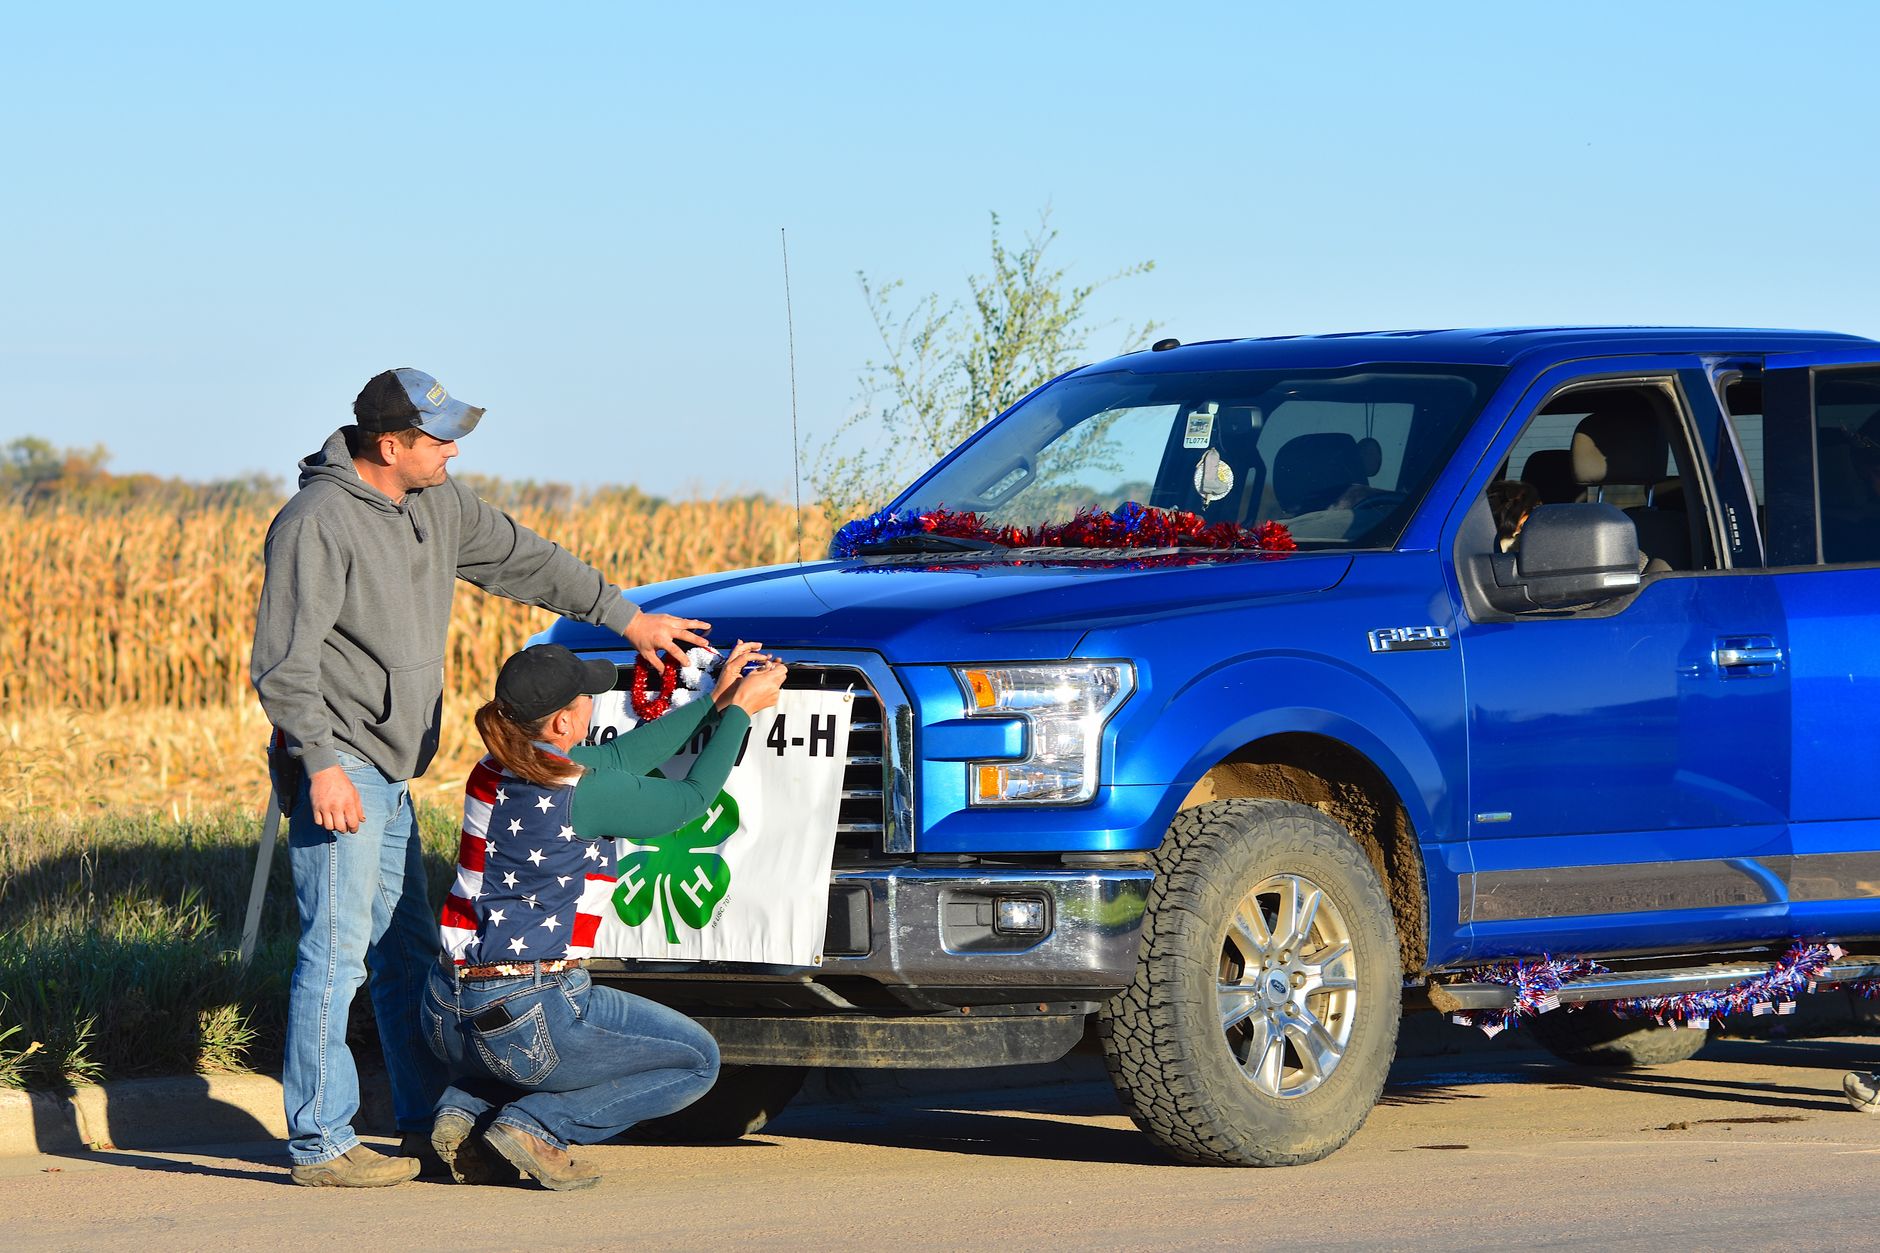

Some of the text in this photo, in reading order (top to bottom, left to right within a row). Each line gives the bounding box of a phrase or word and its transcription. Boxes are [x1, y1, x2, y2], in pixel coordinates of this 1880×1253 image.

[766, 714, 836, 757] 4-H
[615, 863, 646, 906] H
[679, 864, 714, 909] H
[711, 894, 732, 929] 18 USC 707
